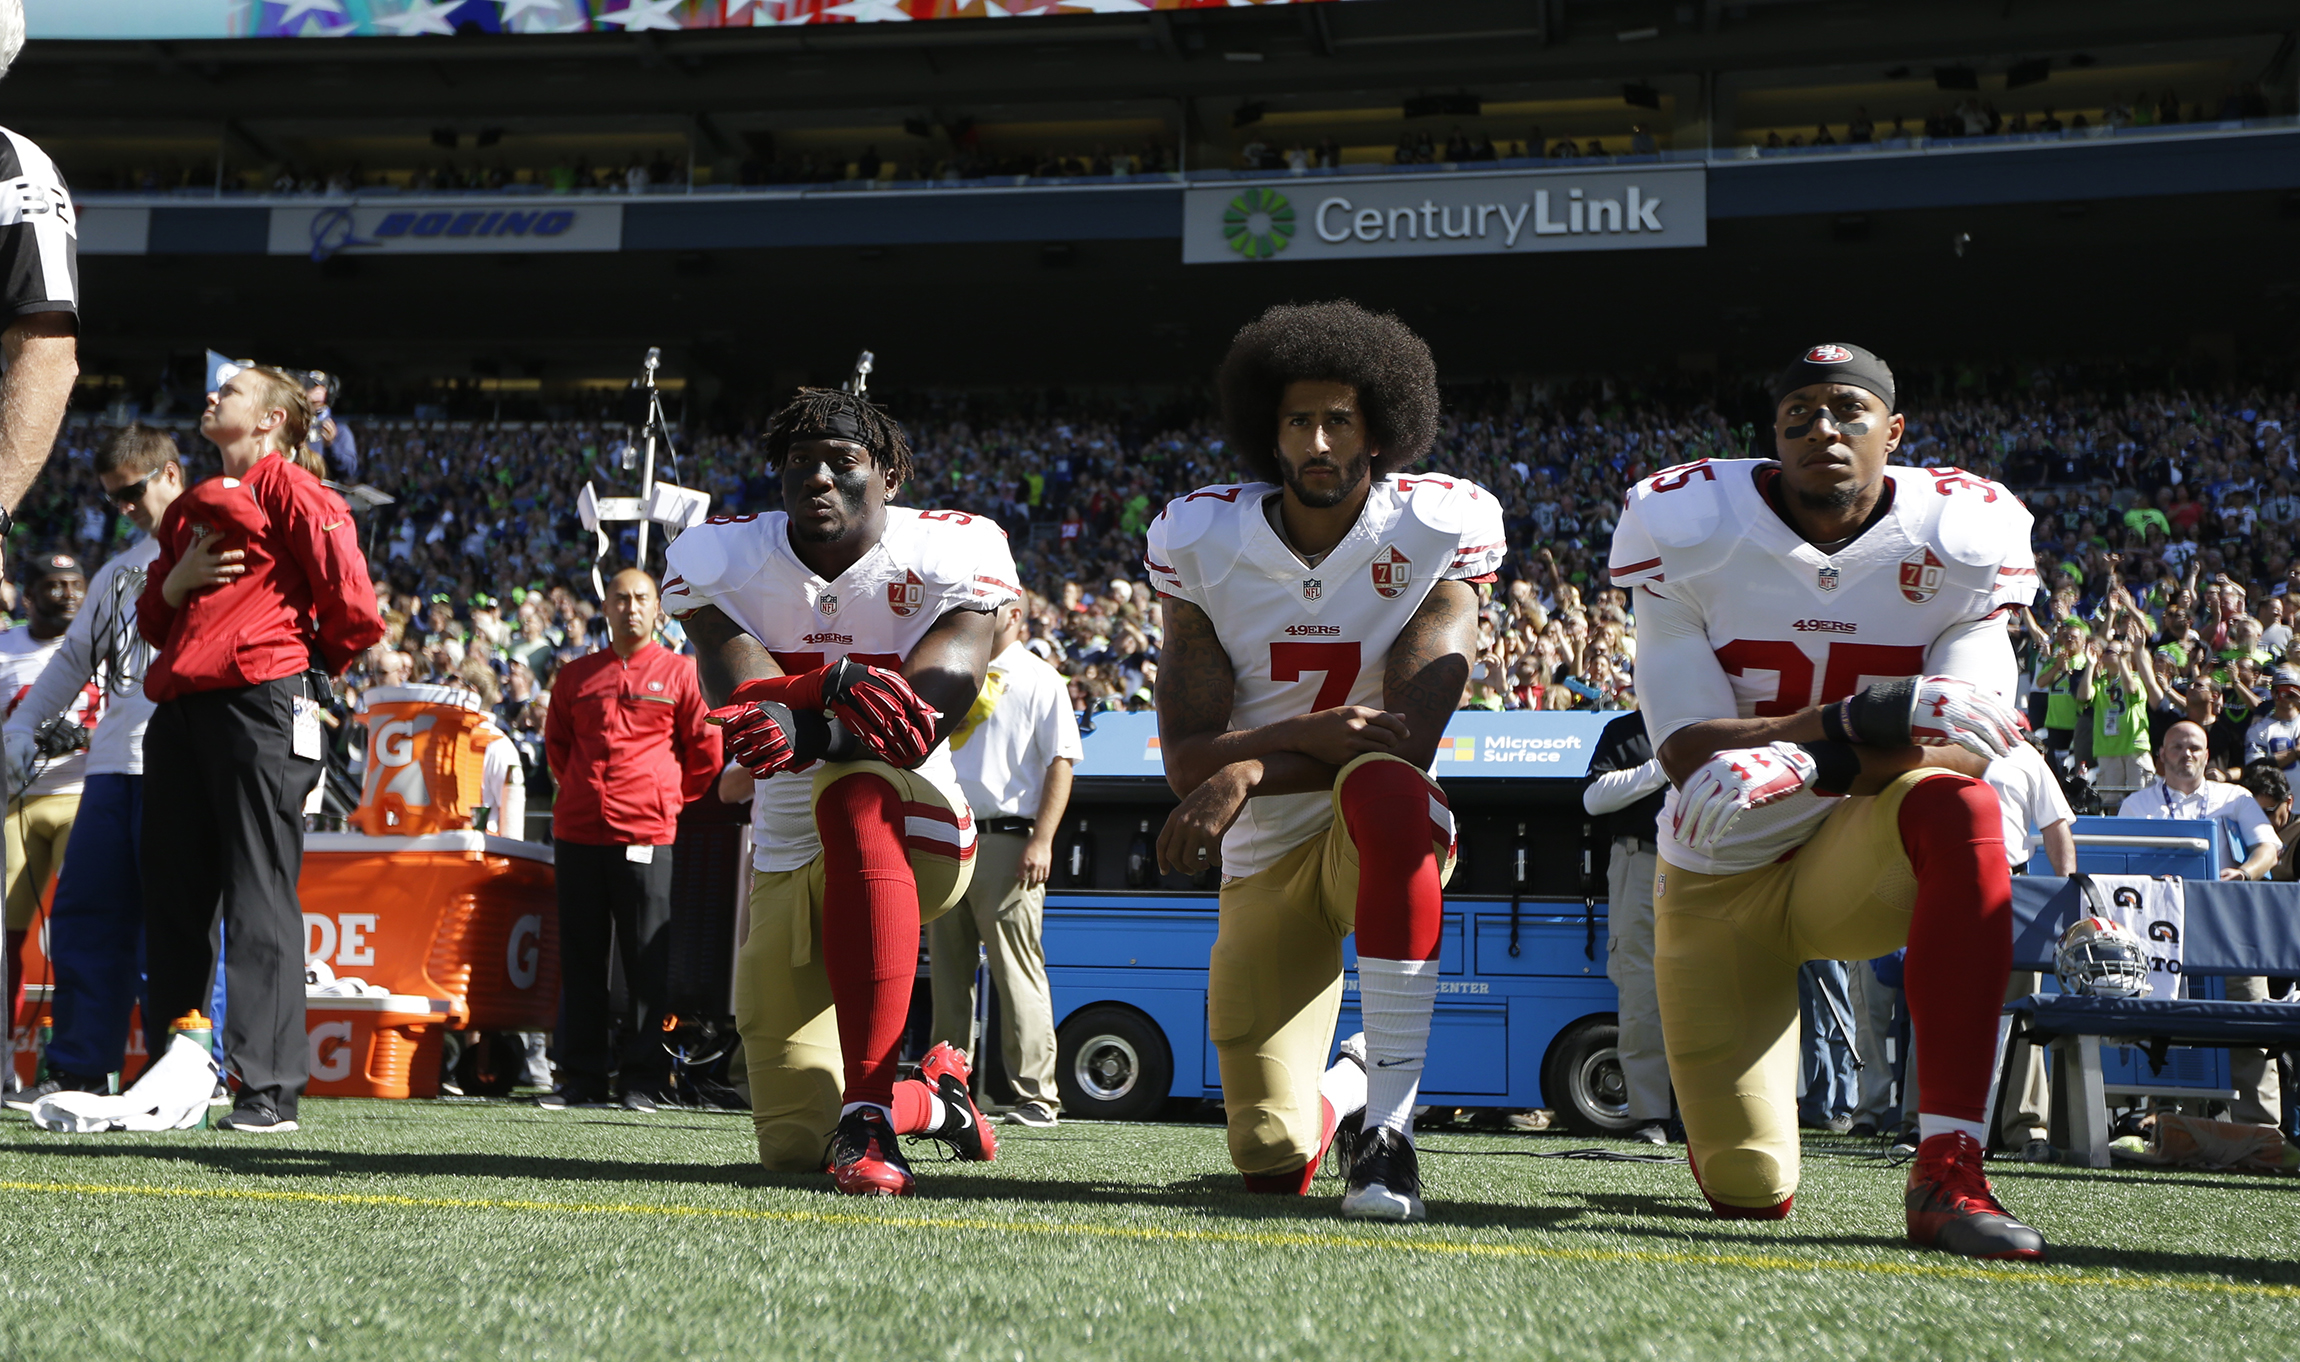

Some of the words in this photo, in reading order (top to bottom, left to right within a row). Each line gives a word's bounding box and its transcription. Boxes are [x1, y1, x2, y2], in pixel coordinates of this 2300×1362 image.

[373, 210, 577, 238] BOEING
[1315, 186, 1663, 248] CenturyLink
[1398, 478, 1453, 492] 7
[1185, 488, 1243, 503] 7
[1820, 577, 1836, 588] NFL
[1306, 587, 1320, 598] NFL
[822, 603, 836, 612] NFL
[1284, 624, 1340, 636] 49ERS
[1792, 619, 1857, 634] 49ERS
[802, 633, 853, 645] 49ERS
[1269, 641, 1361, 713] 7
[376, 720, 413, 767] G
[1485, 735, 1582, 749] Microsoft
[1484, 749, 1561, 763] Surface
[507, 913, 542, 990] G
[306, 1020, 353, 1083] G
